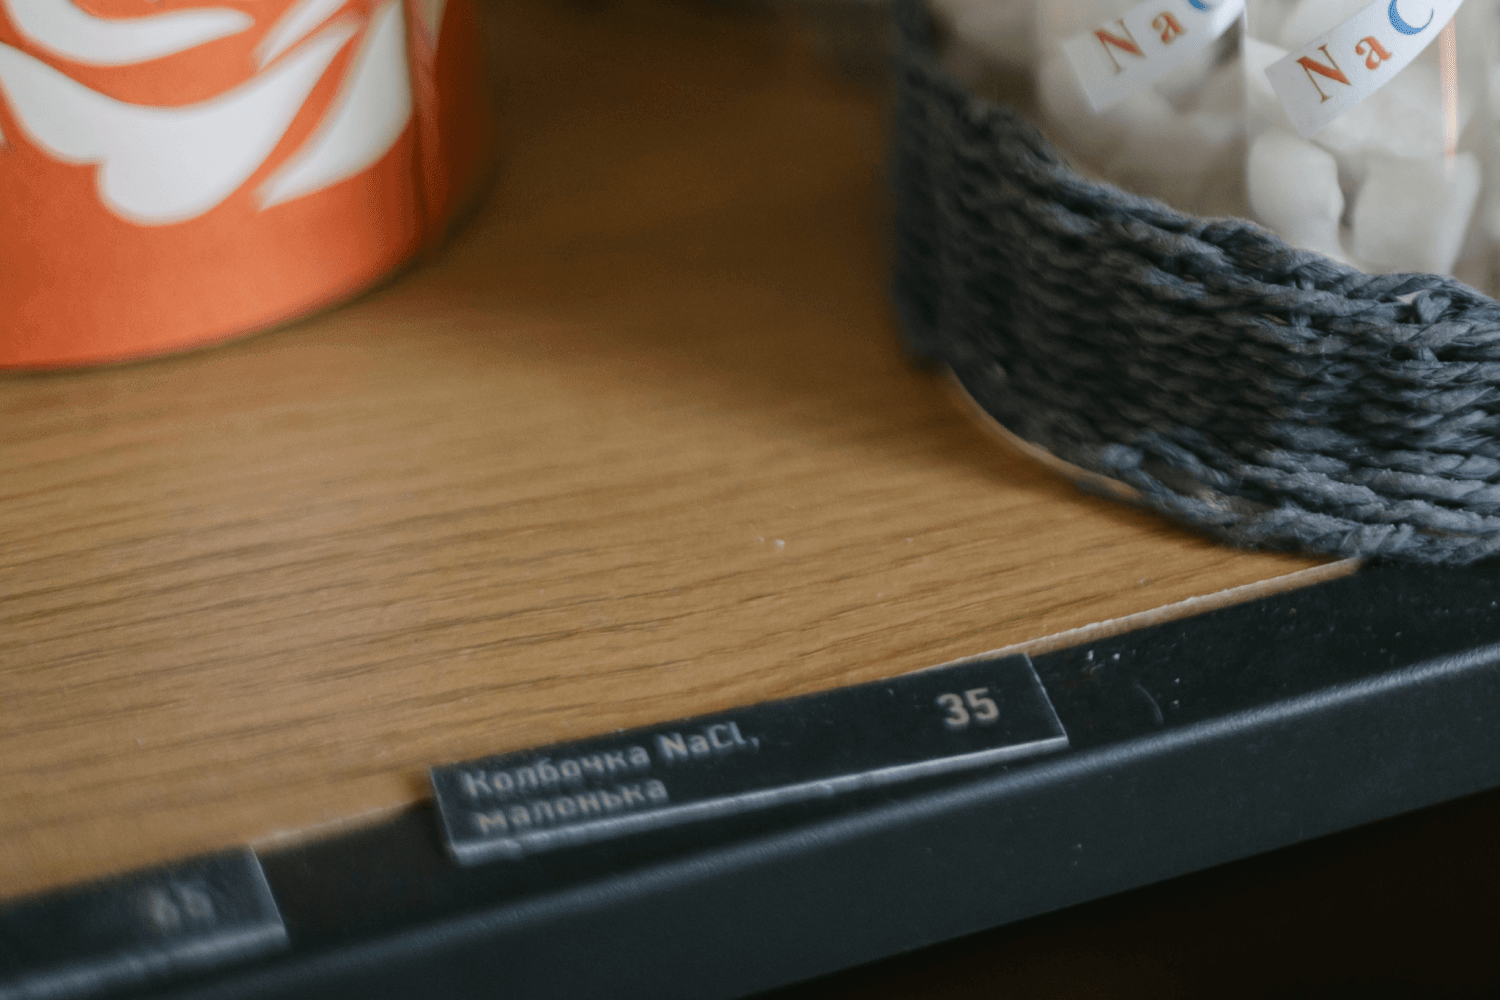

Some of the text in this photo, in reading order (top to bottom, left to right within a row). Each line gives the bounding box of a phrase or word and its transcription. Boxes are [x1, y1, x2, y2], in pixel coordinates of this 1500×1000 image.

[936, 686, 1000, 729] 35
[461, 720, 761, 798] Колбочка NaCl,
